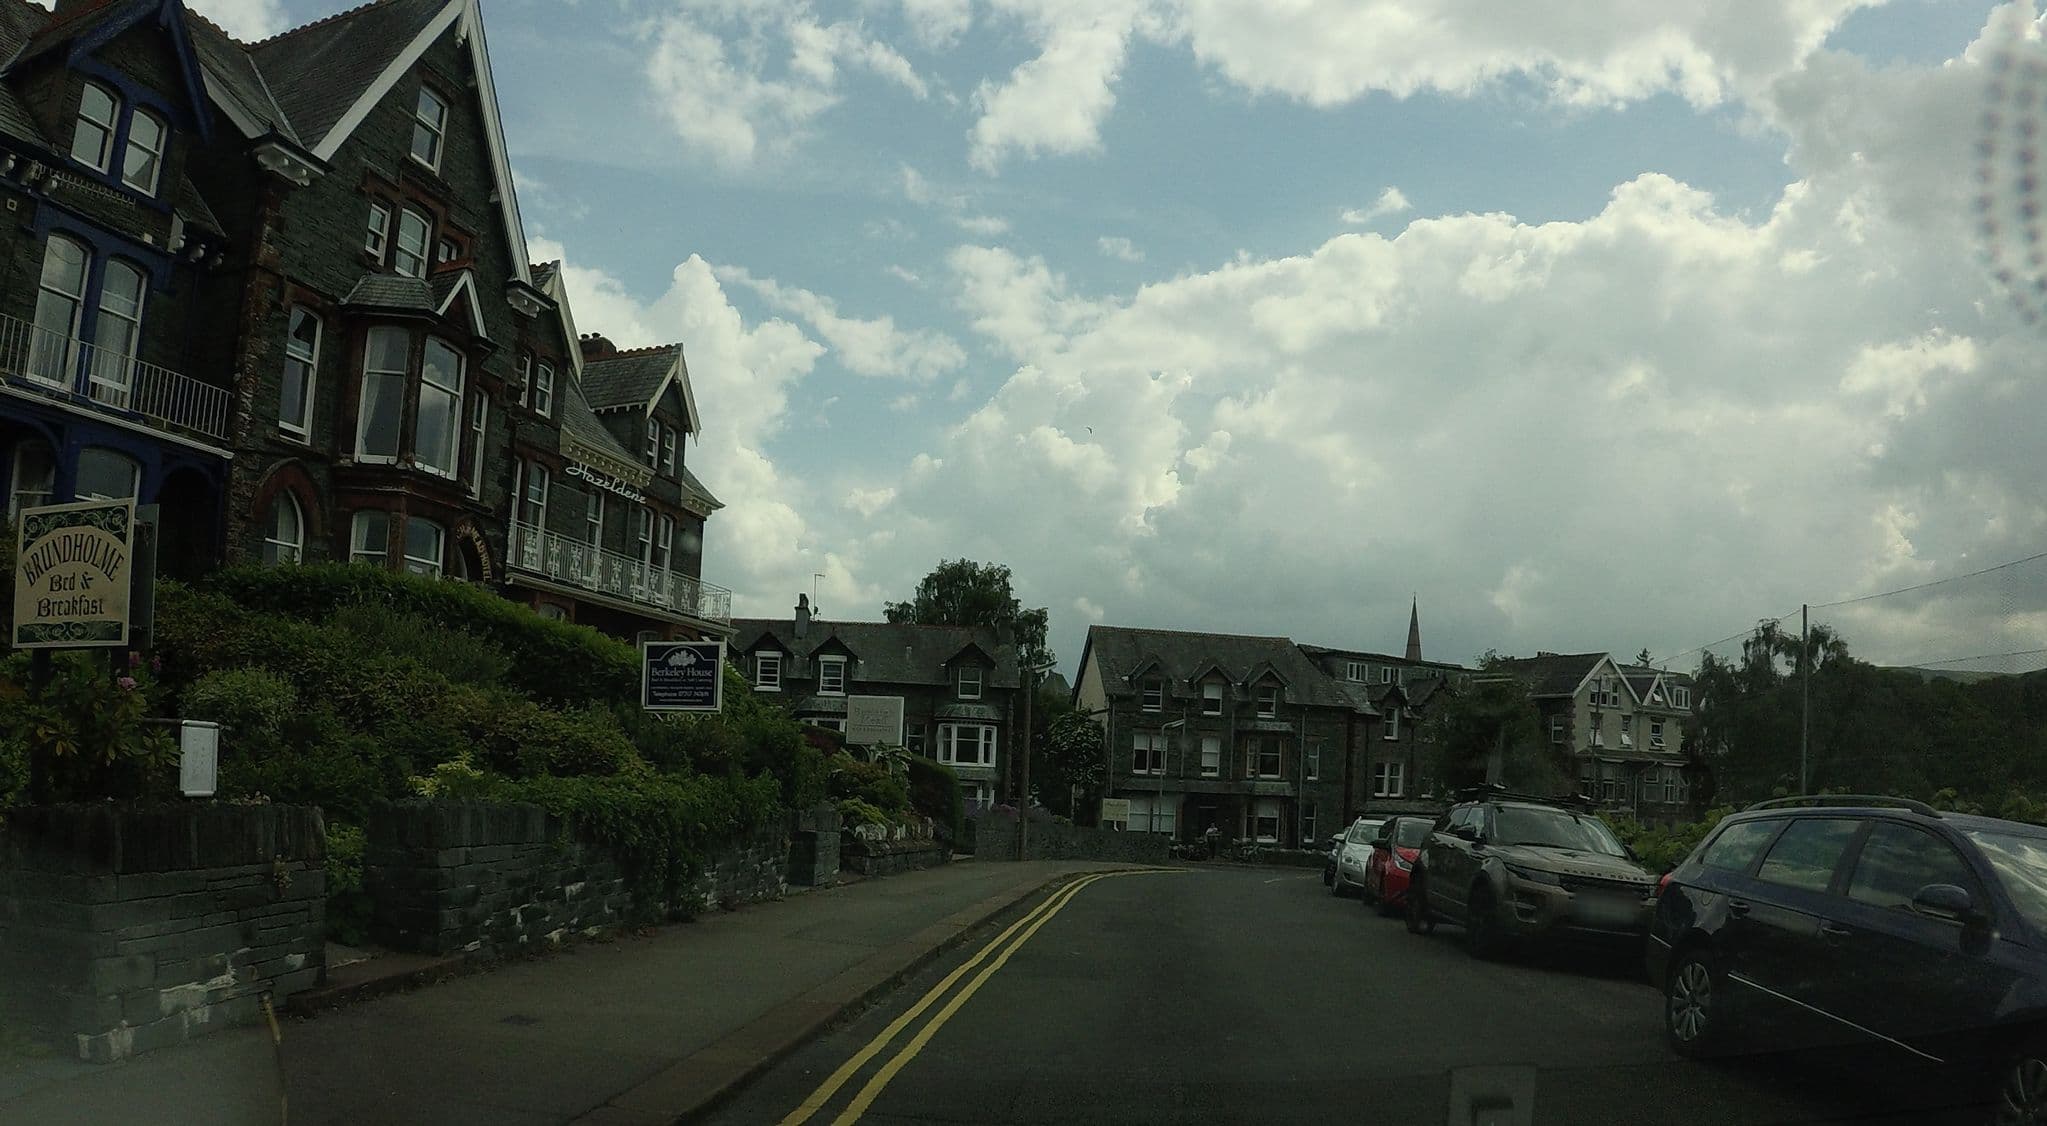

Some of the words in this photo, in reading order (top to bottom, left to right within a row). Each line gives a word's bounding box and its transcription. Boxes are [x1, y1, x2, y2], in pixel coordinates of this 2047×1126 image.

[564, 461, 647, 504] Hazeldene
[22, 533, 125, 587] BRUNDHOLME
[49, 572, 76, 592] Bed
[80, 571, 95, 591] &
[36, 594, 105, 618] Breakfast
[651, 667, 685, 679] Berkeley
[687, 667, 713, 677] House
